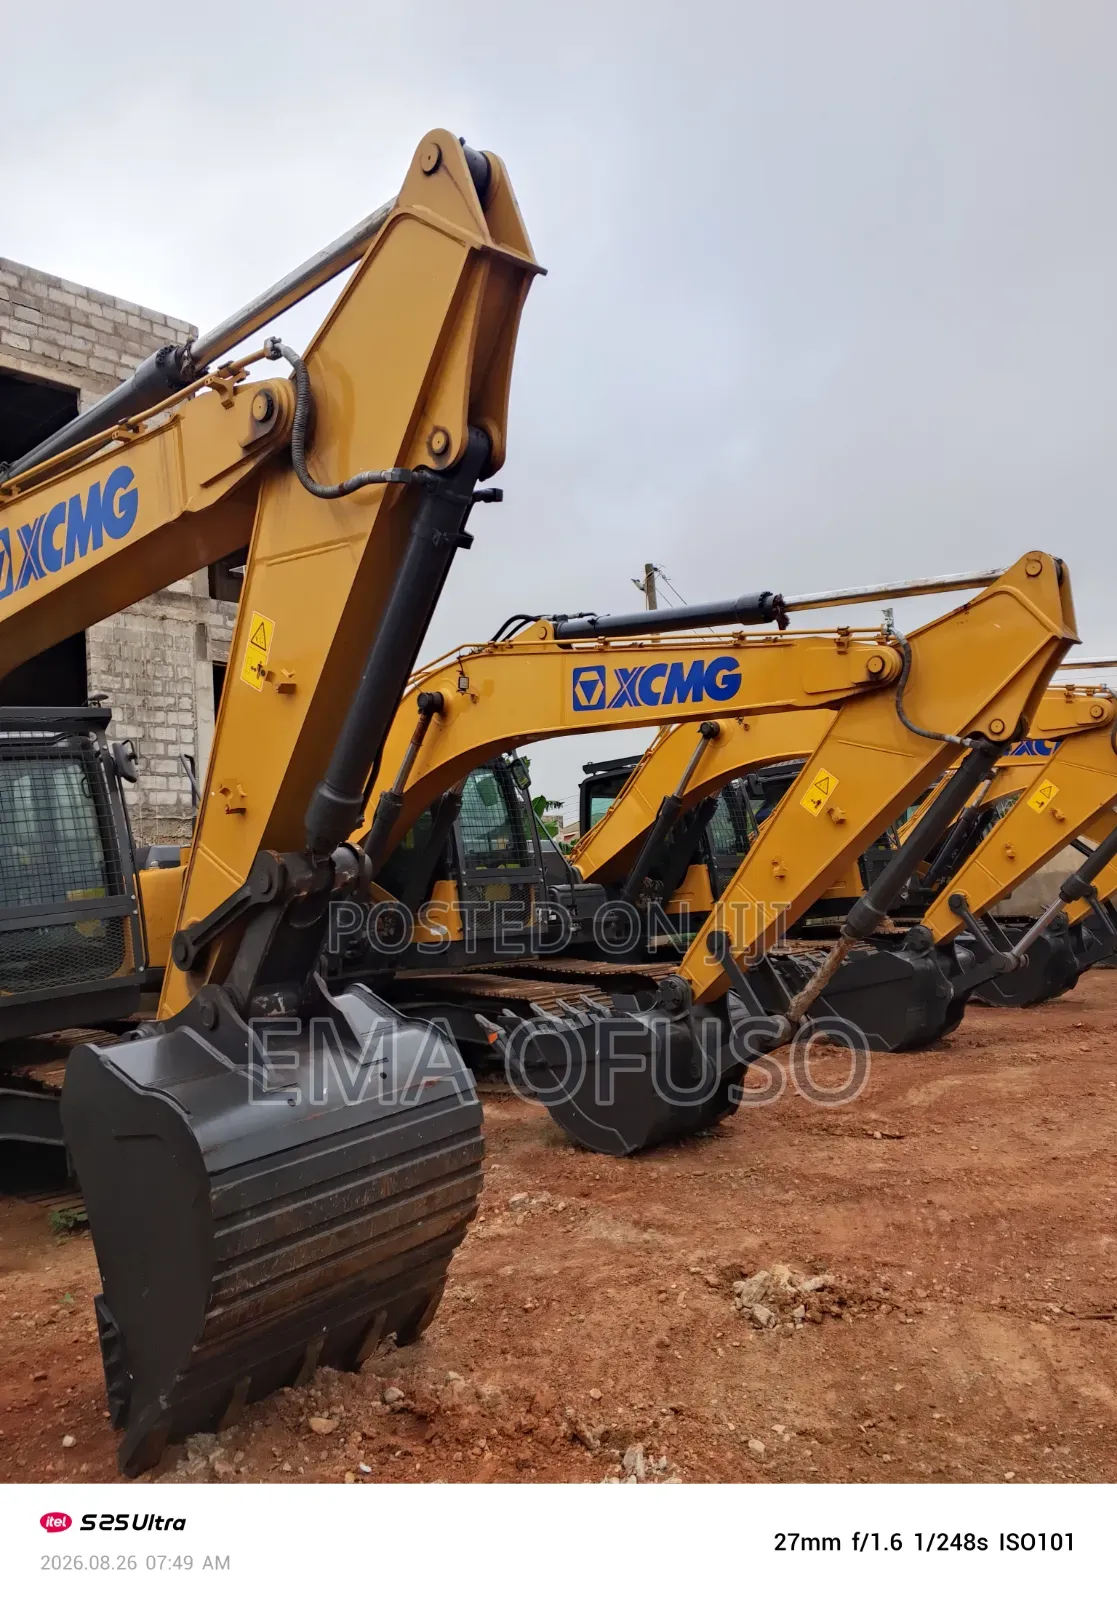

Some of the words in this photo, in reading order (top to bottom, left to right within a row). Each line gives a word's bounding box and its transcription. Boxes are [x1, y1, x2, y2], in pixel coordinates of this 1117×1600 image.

[14, 465, 138, 592] XCMG
[606, 656, 742, 709] XCMG
[1009, 740, 1062, 756] XC
